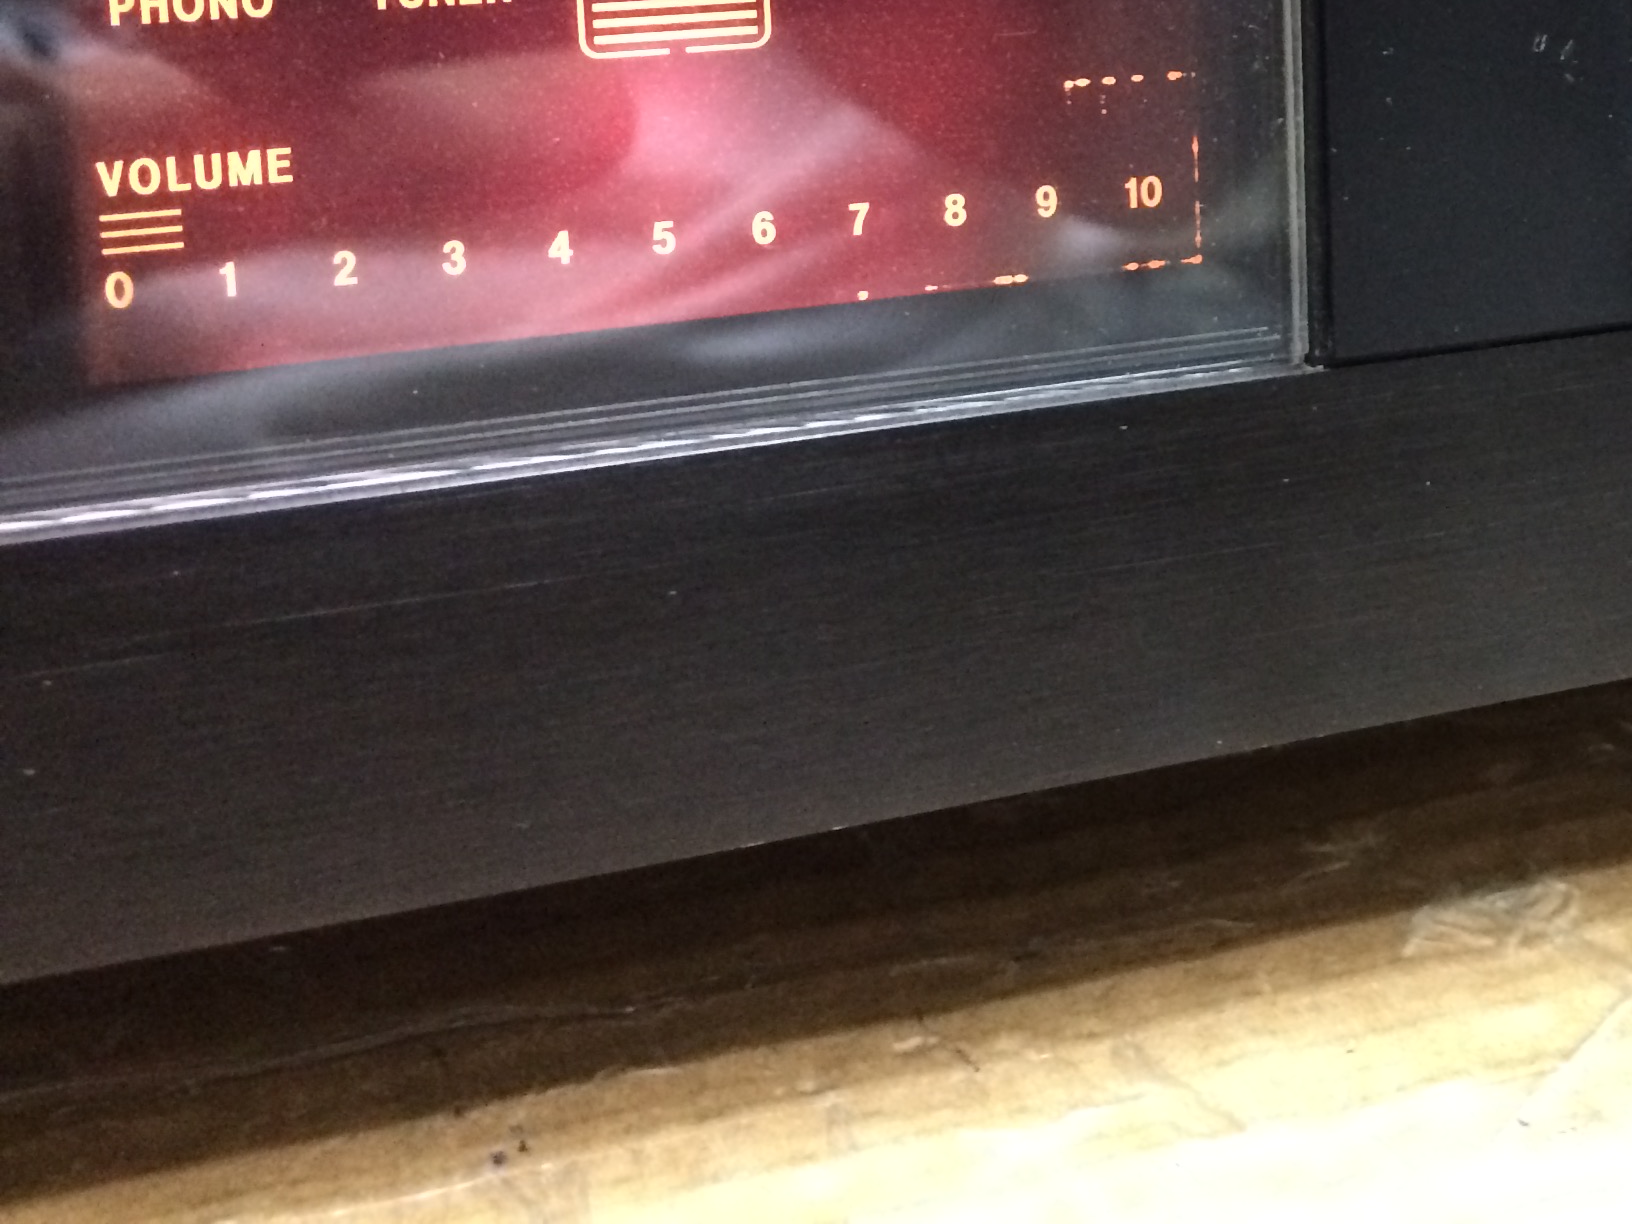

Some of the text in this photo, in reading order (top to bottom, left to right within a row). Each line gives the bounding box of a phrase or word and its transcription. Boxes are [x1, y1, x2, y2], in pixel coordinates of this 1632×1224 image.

[94, 146, 294, 198] VOLUME
[103, 175, 1163, 310] 0 1 2 3 4 5 6 7 8 9 10
